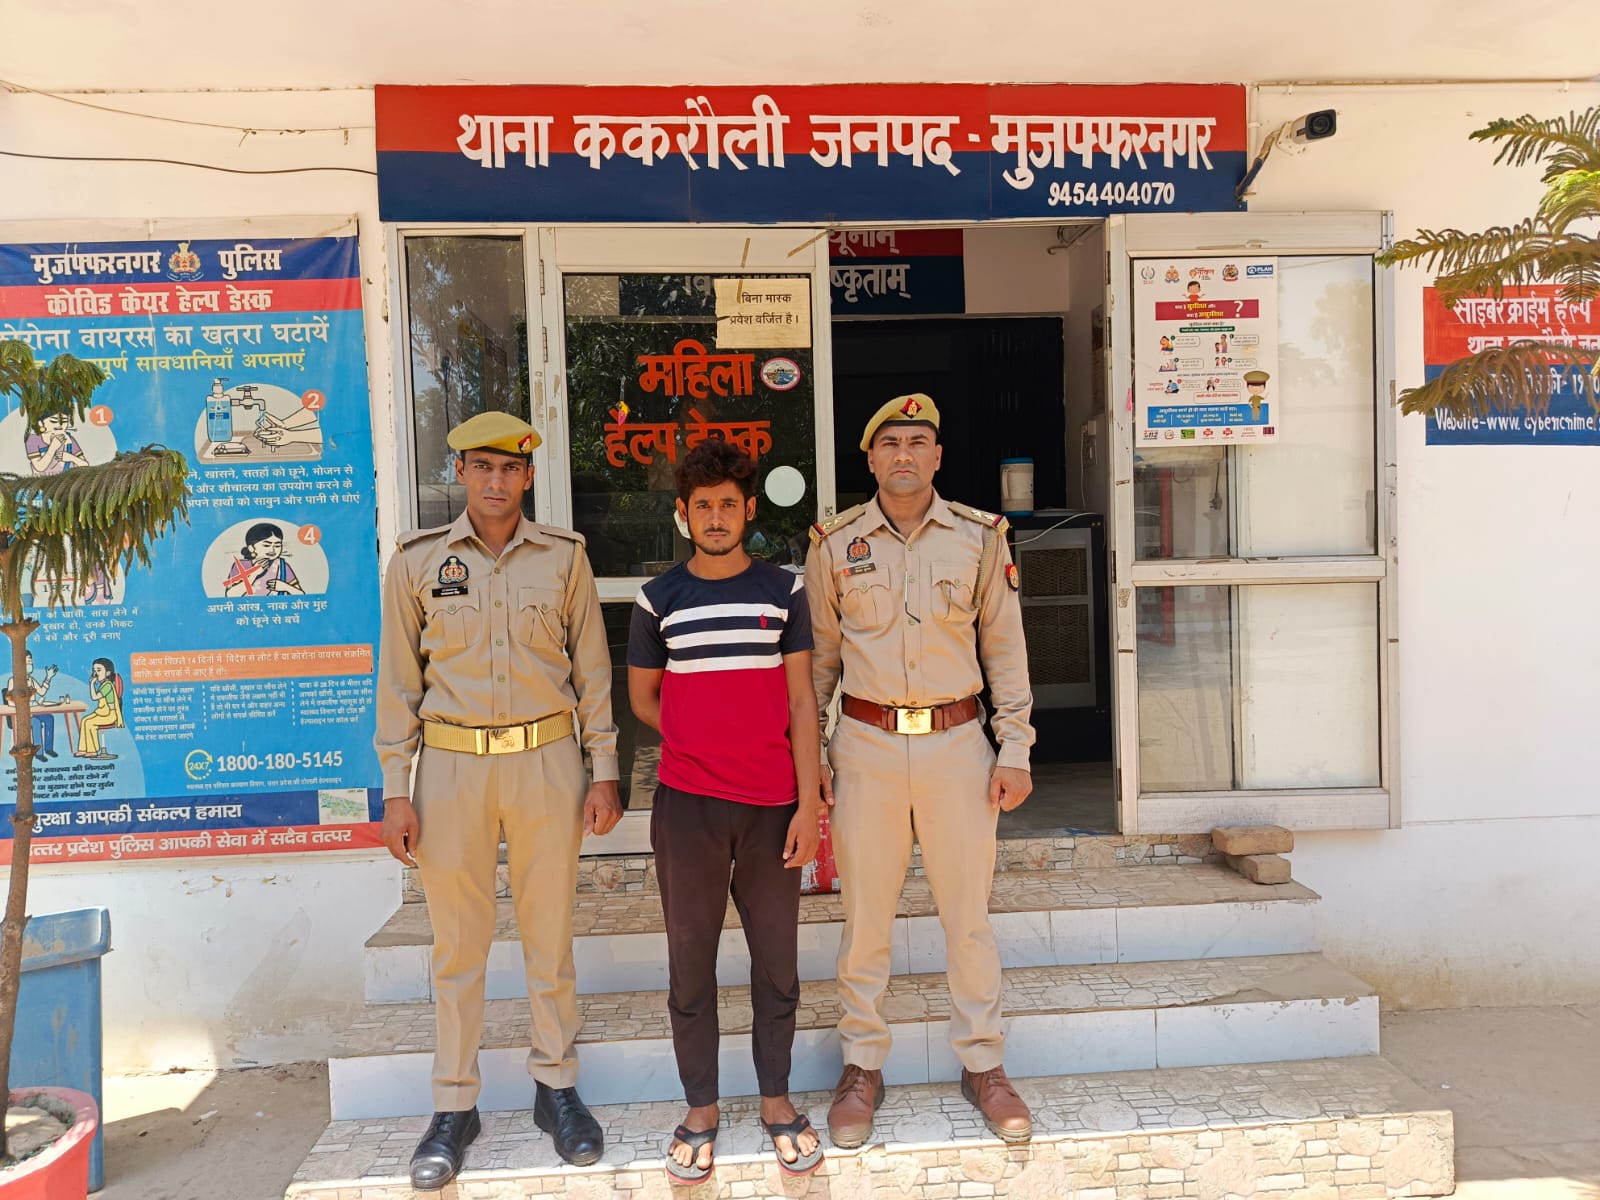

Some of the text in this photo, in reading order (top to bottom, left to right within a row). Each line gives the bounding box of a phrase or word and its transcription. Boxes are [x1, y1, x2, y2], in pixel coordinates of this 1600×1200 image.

[456, 113, 554, 169] थाना
[573, 94, 790, 171] ककरौली
[809, 114, 960, 176] जनपद
[1048, 181, 1175, 206] 9454404070
[218, 243, 282, 280] पुलिस
[44, 284, 273, 315] कोविड केयर हेल्प डेस्क
[741, 291, 792, 305] बिना मास्क
[730, 312, 752, 325] प्रवेश
[755, 311, 782, 325] वर्जित
[1453, 297, 1508, 329] साइबर
[79, 324, 155, 349] वायरस
[163, 325, 193, 347] का
[202, 324, 263, 346] खतरा
[242, 348, 306, 373] अपनाएं
[637, 338, 755, 400] महिला
[307, 392, 321, 409] 2
[95, 408, 106, 424] 1
[603, 405, 680, 469] हेल्प
[303, 527, 316, 545] 4
[217, 750, 344, 773] 1800-180-5145
[75, 805, 132, 825] आपकी
[137, 802, 190, 822] संकल्प
[196, 804, 242, 821] हमारा
[67, 837, 104, 856] प्रदेश
[109, 834, 154, 859] पुलिस
[159, 832, 212, 852] आपकी
[216, 832, 247, 850] सेवा
[251, 830, 266, 847] में
[271, 828, 308, 846] सदैव
[312, 828, 352, 844] तत्पर
